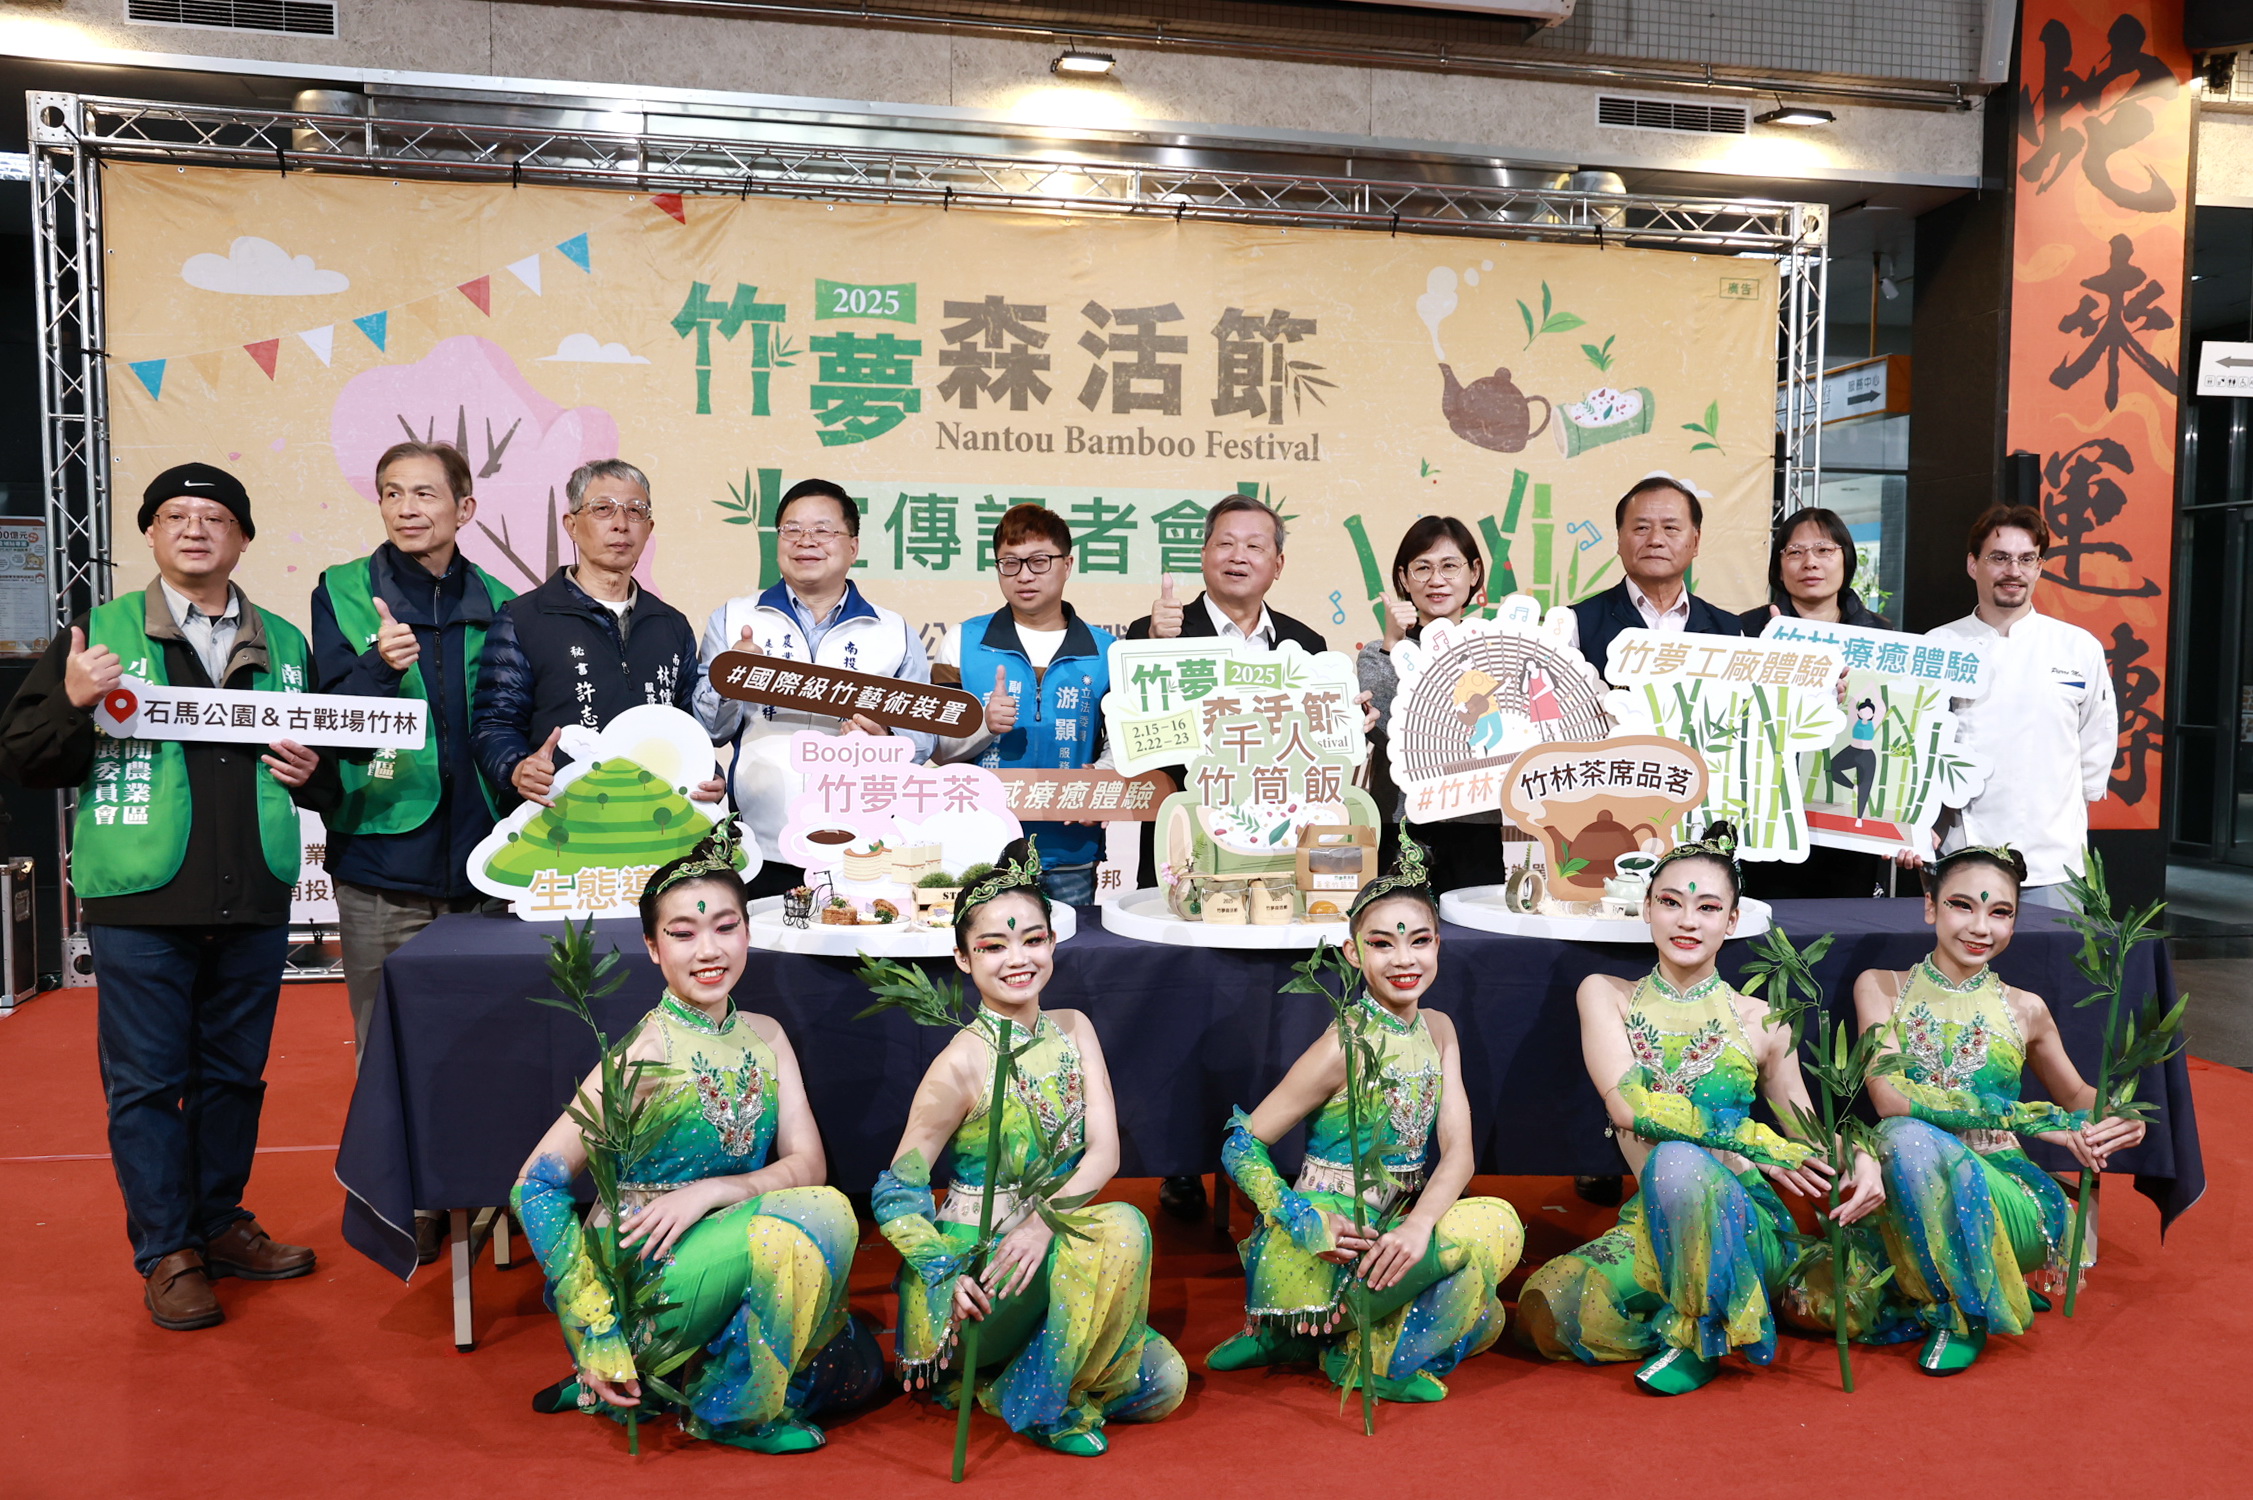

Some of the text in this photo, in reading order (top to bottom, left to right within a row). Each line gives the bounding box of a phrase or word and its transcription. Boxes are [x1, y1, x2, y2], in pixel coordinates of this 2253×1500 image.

[832, 288, 901, 315] 2025
[1727, 282, 1752, 296] 廣告
[1847, 374, 1880, 392] 服務中心
[936, 421, 1321, 462] Nantou Bamboo Festival
[846, 491, 1209, 575] 傳者會
[1618, 638, 1834, 689] 竹夢工廠體驗
[726, 665, 968, 726] #國際級竹藝術裝置
[1131, 658, 1276, 712] 竹夢 2025
[802, 741, 904, 767] Boojour
[1222, 721, 1316, 764] 千人
[817, 774, 980, 814] 竹夢午茶
[1196, 765, 1344, 806] 竹筒飯
[1417, 769, 1506, 811] #竹林
[1520, 758, 1694, 800] 竹林茶席品茗
